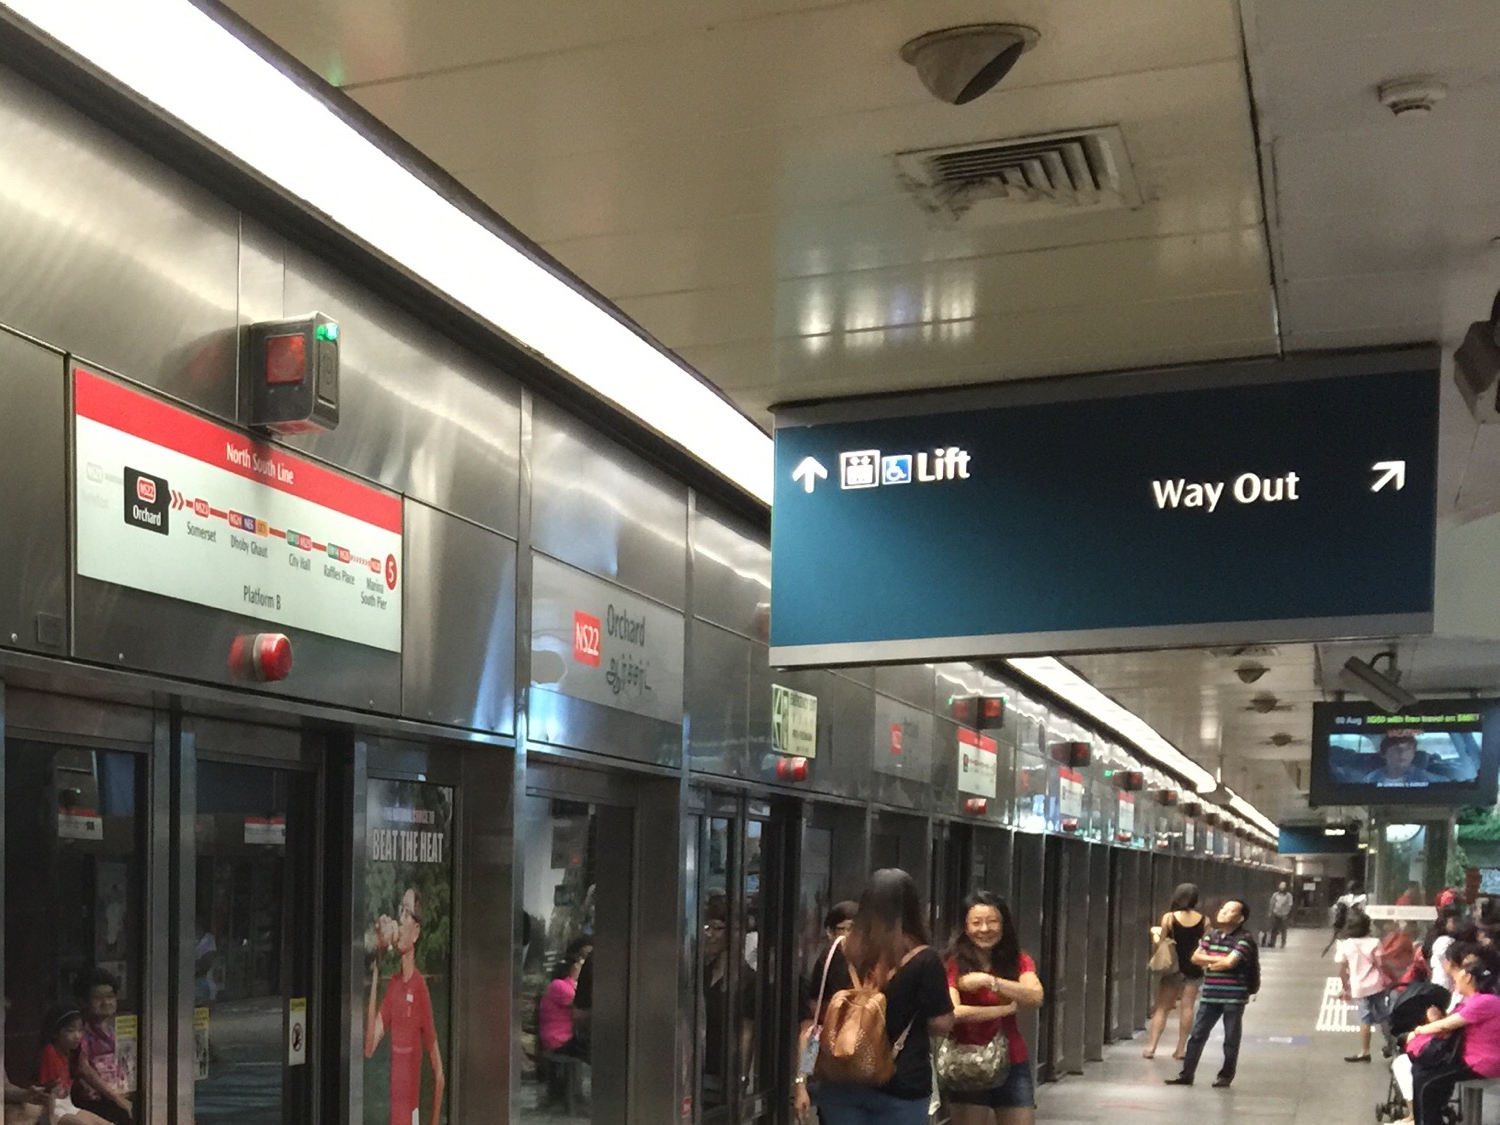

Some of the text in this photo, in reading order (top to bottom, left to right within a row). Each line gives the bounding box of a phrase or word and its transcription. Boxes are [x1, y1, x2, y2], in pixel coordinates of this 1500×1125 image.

[226, 442, 294, 485] North South Line
[917, 447, 971, 482] Lift
[1152, 471, 1300, 513] Way Out
[132, 504, 162, 526] Orchard
[187, 521, 217, 542] Somerset
[230, 534, 249, 554] Dhoby
[250, 541, 268, 559] Ghaut
[289, 553, 311, 571] City Hall
[323, 564, 355, 586] Raffles Place
[243, 584, 281, 610] Platform B
[575, 603, 646, 656] NS22 Orchard
[372, 828, 444, 863] BEAT THE HEAT
